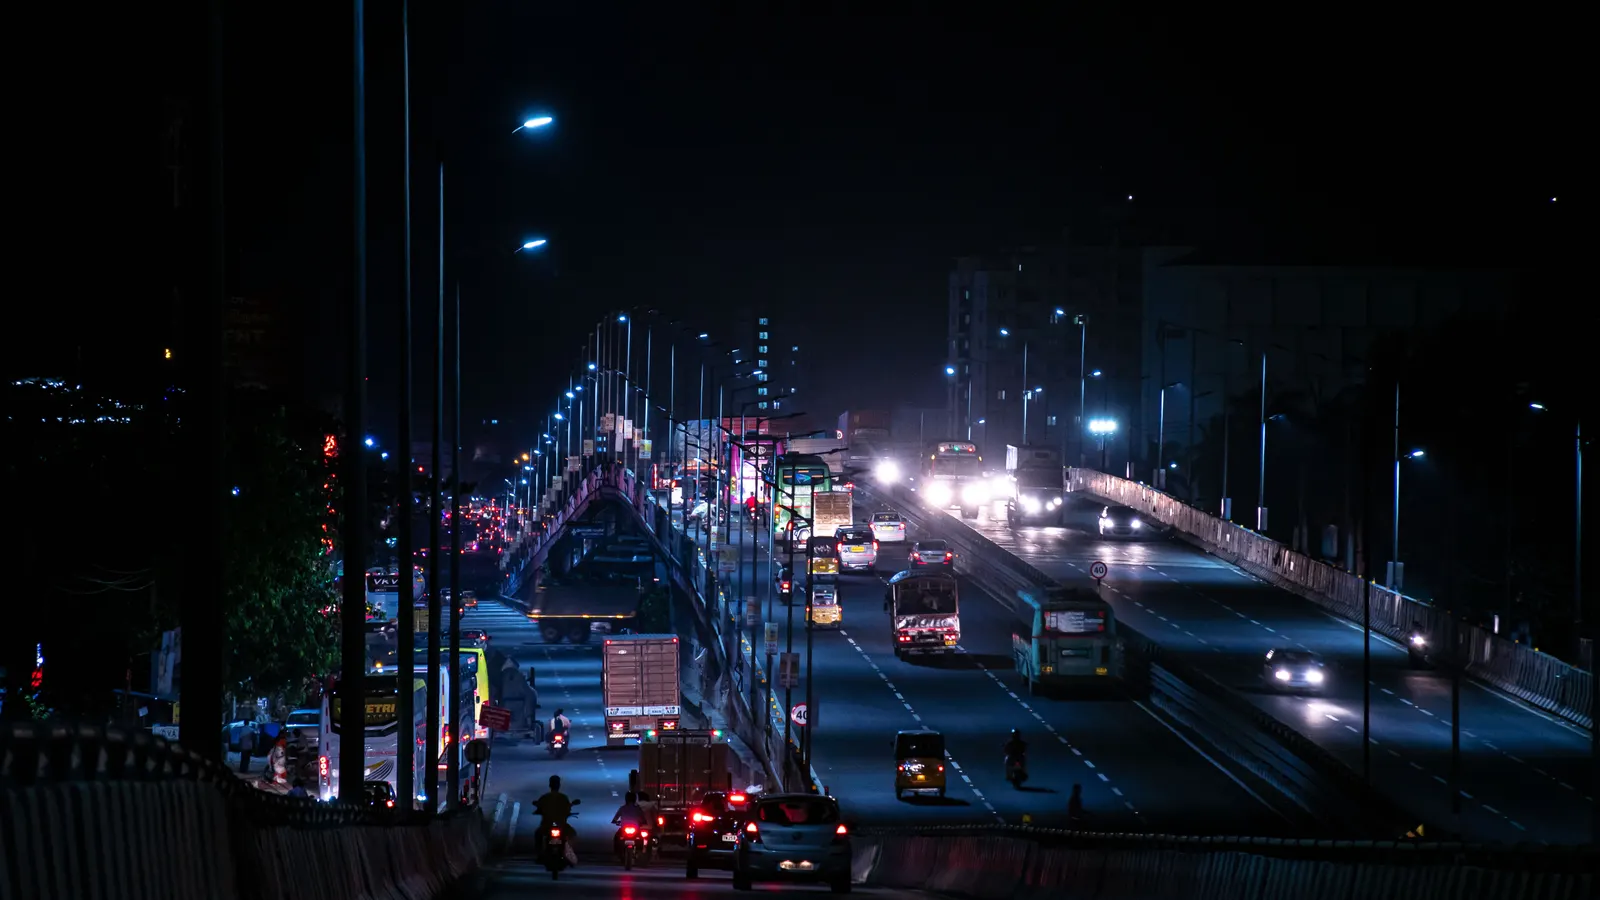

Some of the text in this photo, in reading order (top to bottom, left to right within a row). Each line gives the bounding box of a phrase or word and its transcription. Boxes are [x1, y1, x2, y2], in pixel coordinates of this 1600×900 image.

[1094, 566, 1104, 574] 40
[364, 703, 396, 713] ETRI
[796, 710, 808, 720] 40
